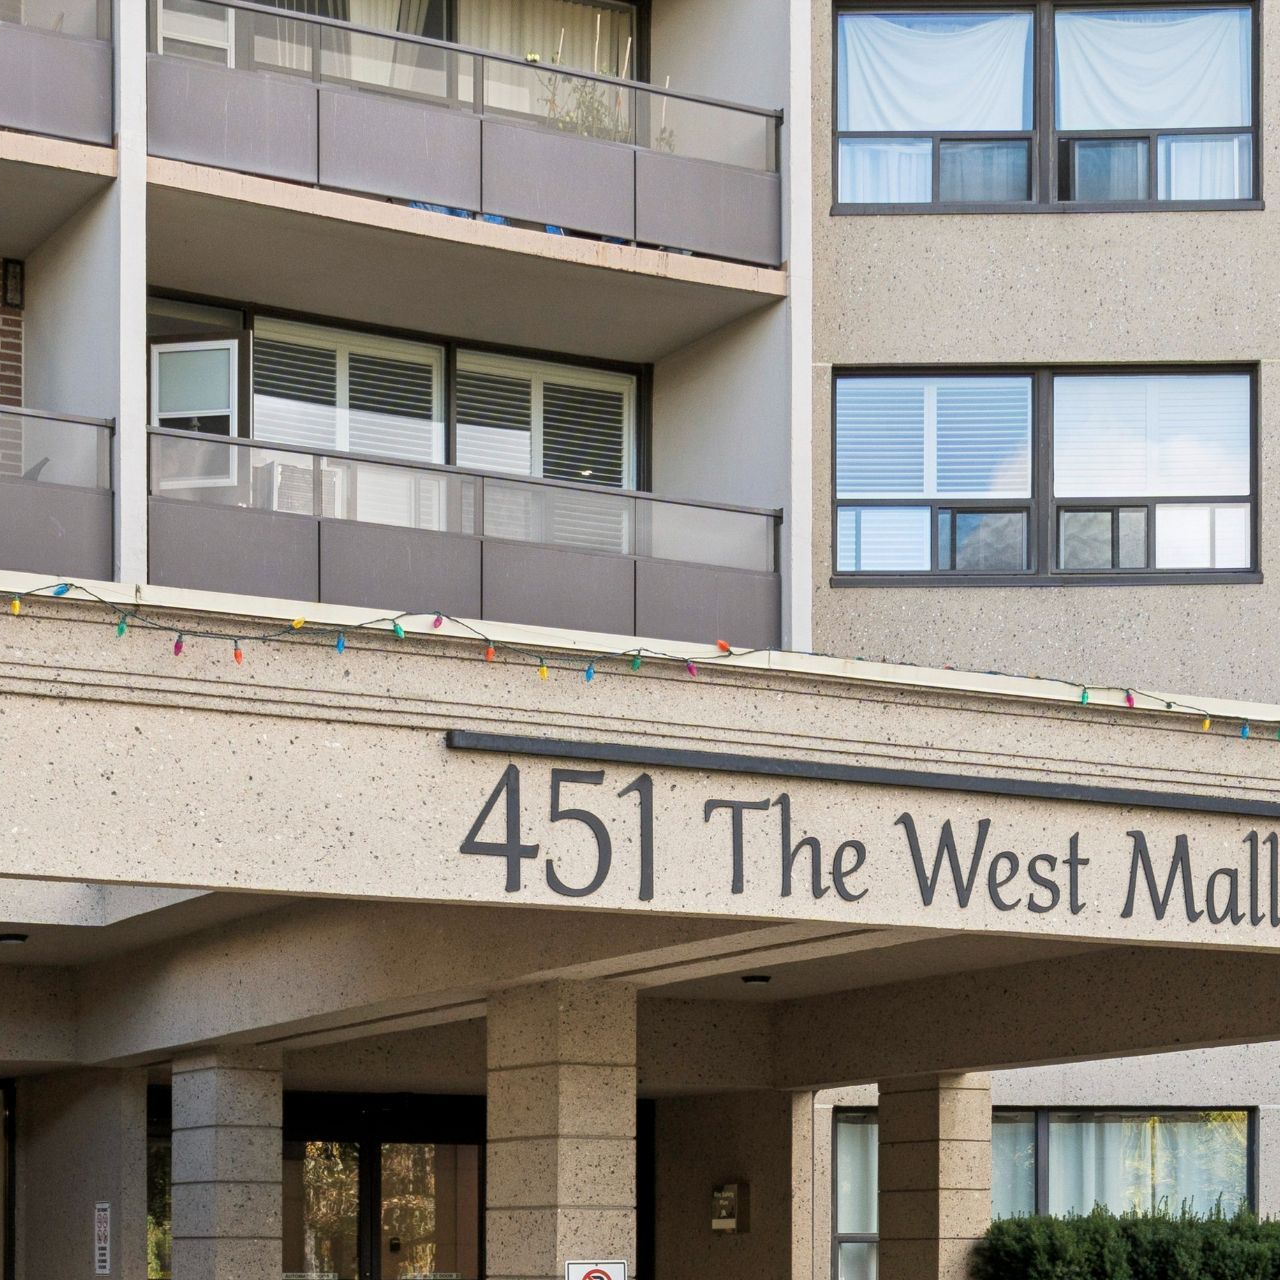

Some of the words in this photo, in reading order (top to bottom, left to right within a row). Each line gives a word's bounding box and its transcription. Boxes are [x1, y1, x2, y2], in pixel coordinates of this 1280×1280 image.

[459, 763, 654, 901] 451
[704, 792, 869, 902] The
[894, 811, 1090, 916] West
